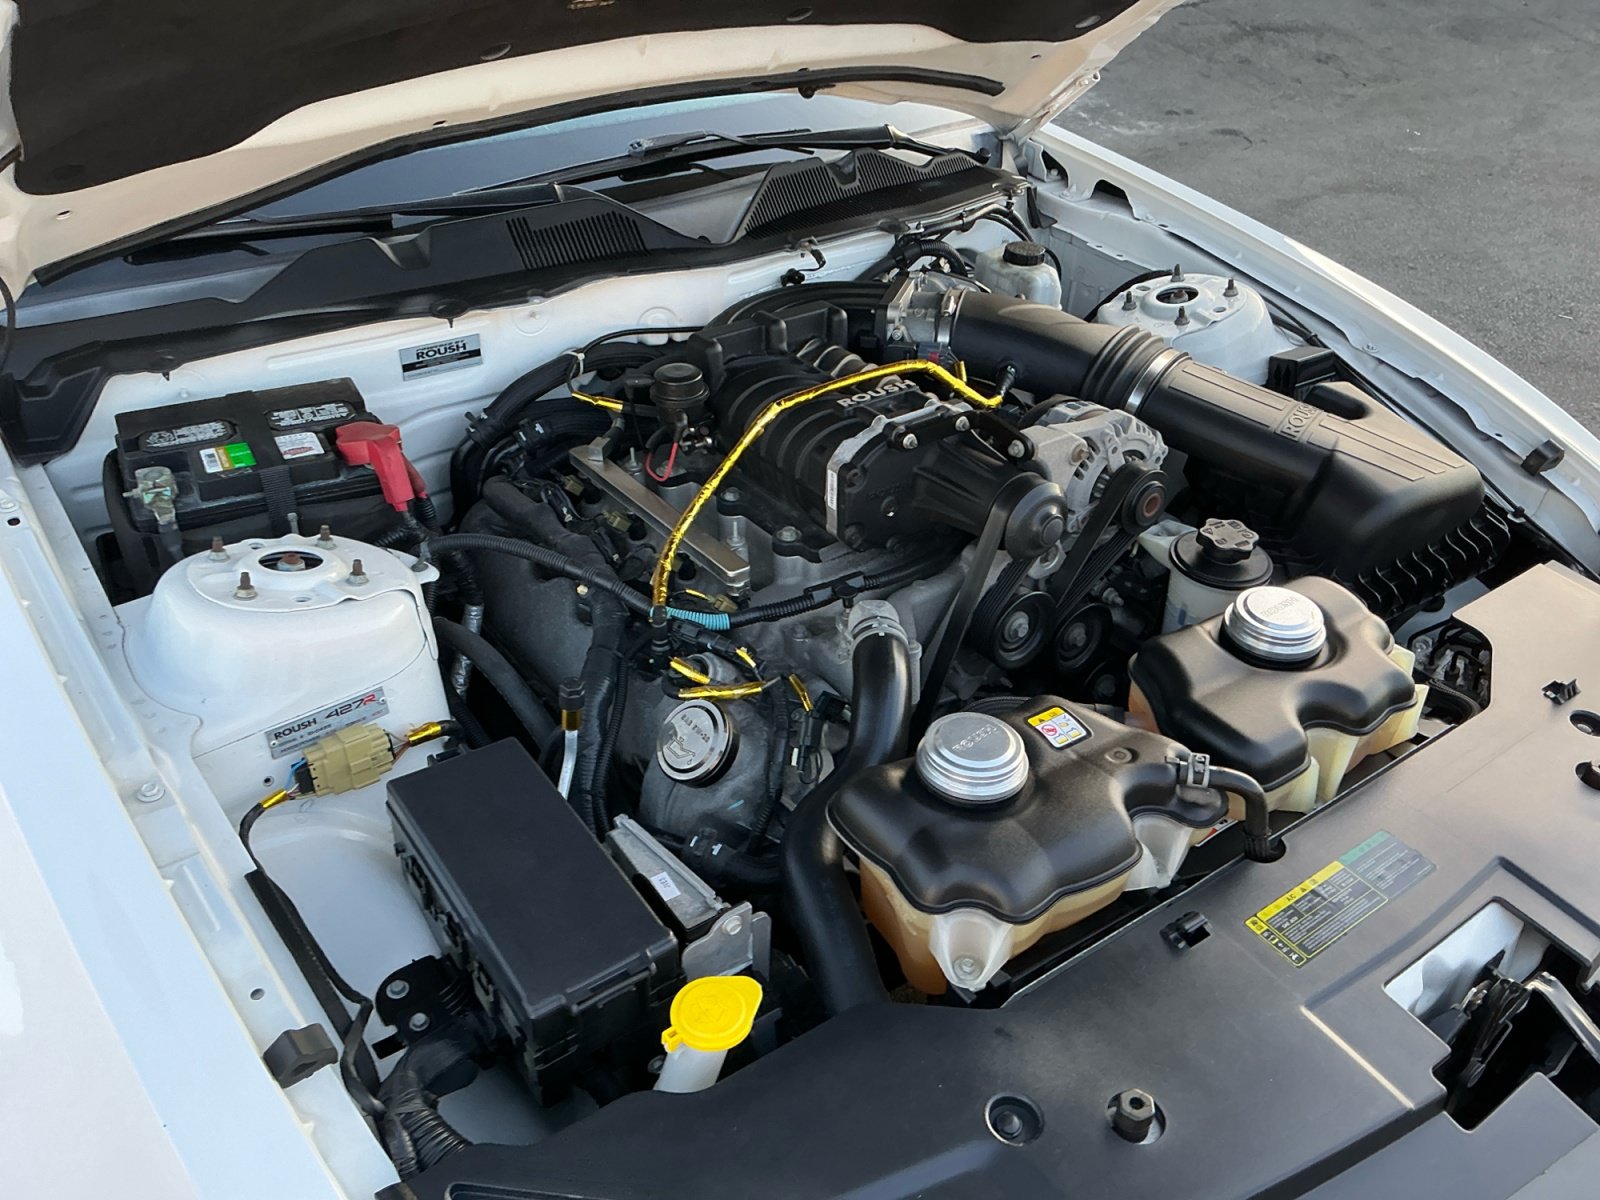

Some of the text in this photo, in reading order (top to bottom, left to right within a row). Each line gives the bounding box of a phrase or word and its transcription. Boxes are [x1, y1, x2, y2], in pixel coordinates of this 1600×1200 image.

[416, 343, 467, 360] ROUSH
[836, 379, 917, 408] ROUSH
[274, 718, 318, 740] ROUSH
[325, 694, 376, 719] 427R
